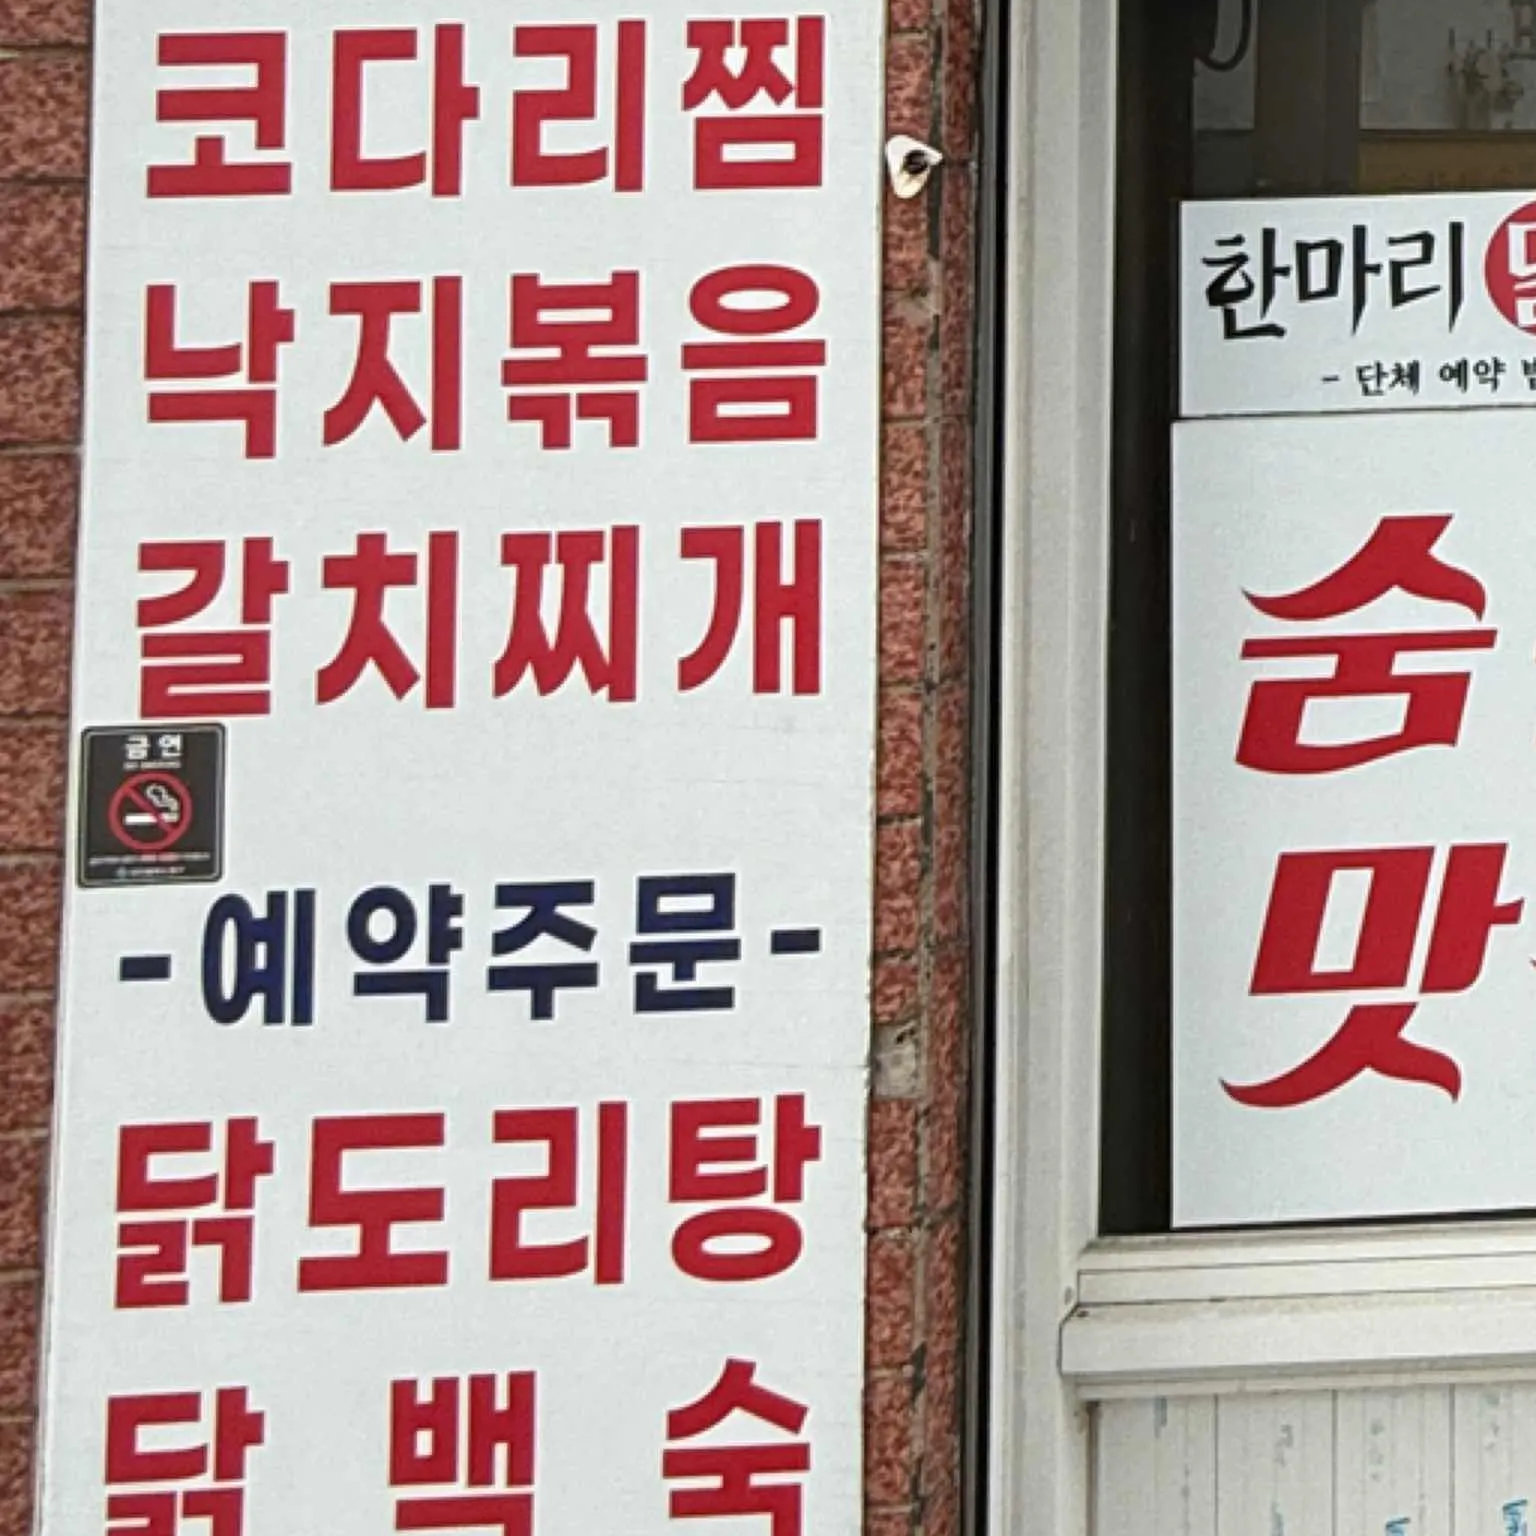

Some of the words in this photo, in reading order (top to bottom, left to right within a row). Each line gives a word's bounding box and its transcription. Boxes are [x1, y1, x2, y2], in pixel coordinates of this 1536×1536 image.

[146, 17, 824, 199] 코다리찜
[145, 265, 825, 458] 낙지볶음
[1357, 361, 1419, 396] 단체
[1438, 358, 1504, 391] 예약
[137, 520, 821, 719] 갈치찌개
[115, 1094, 820, 1309] 닭도리탕
